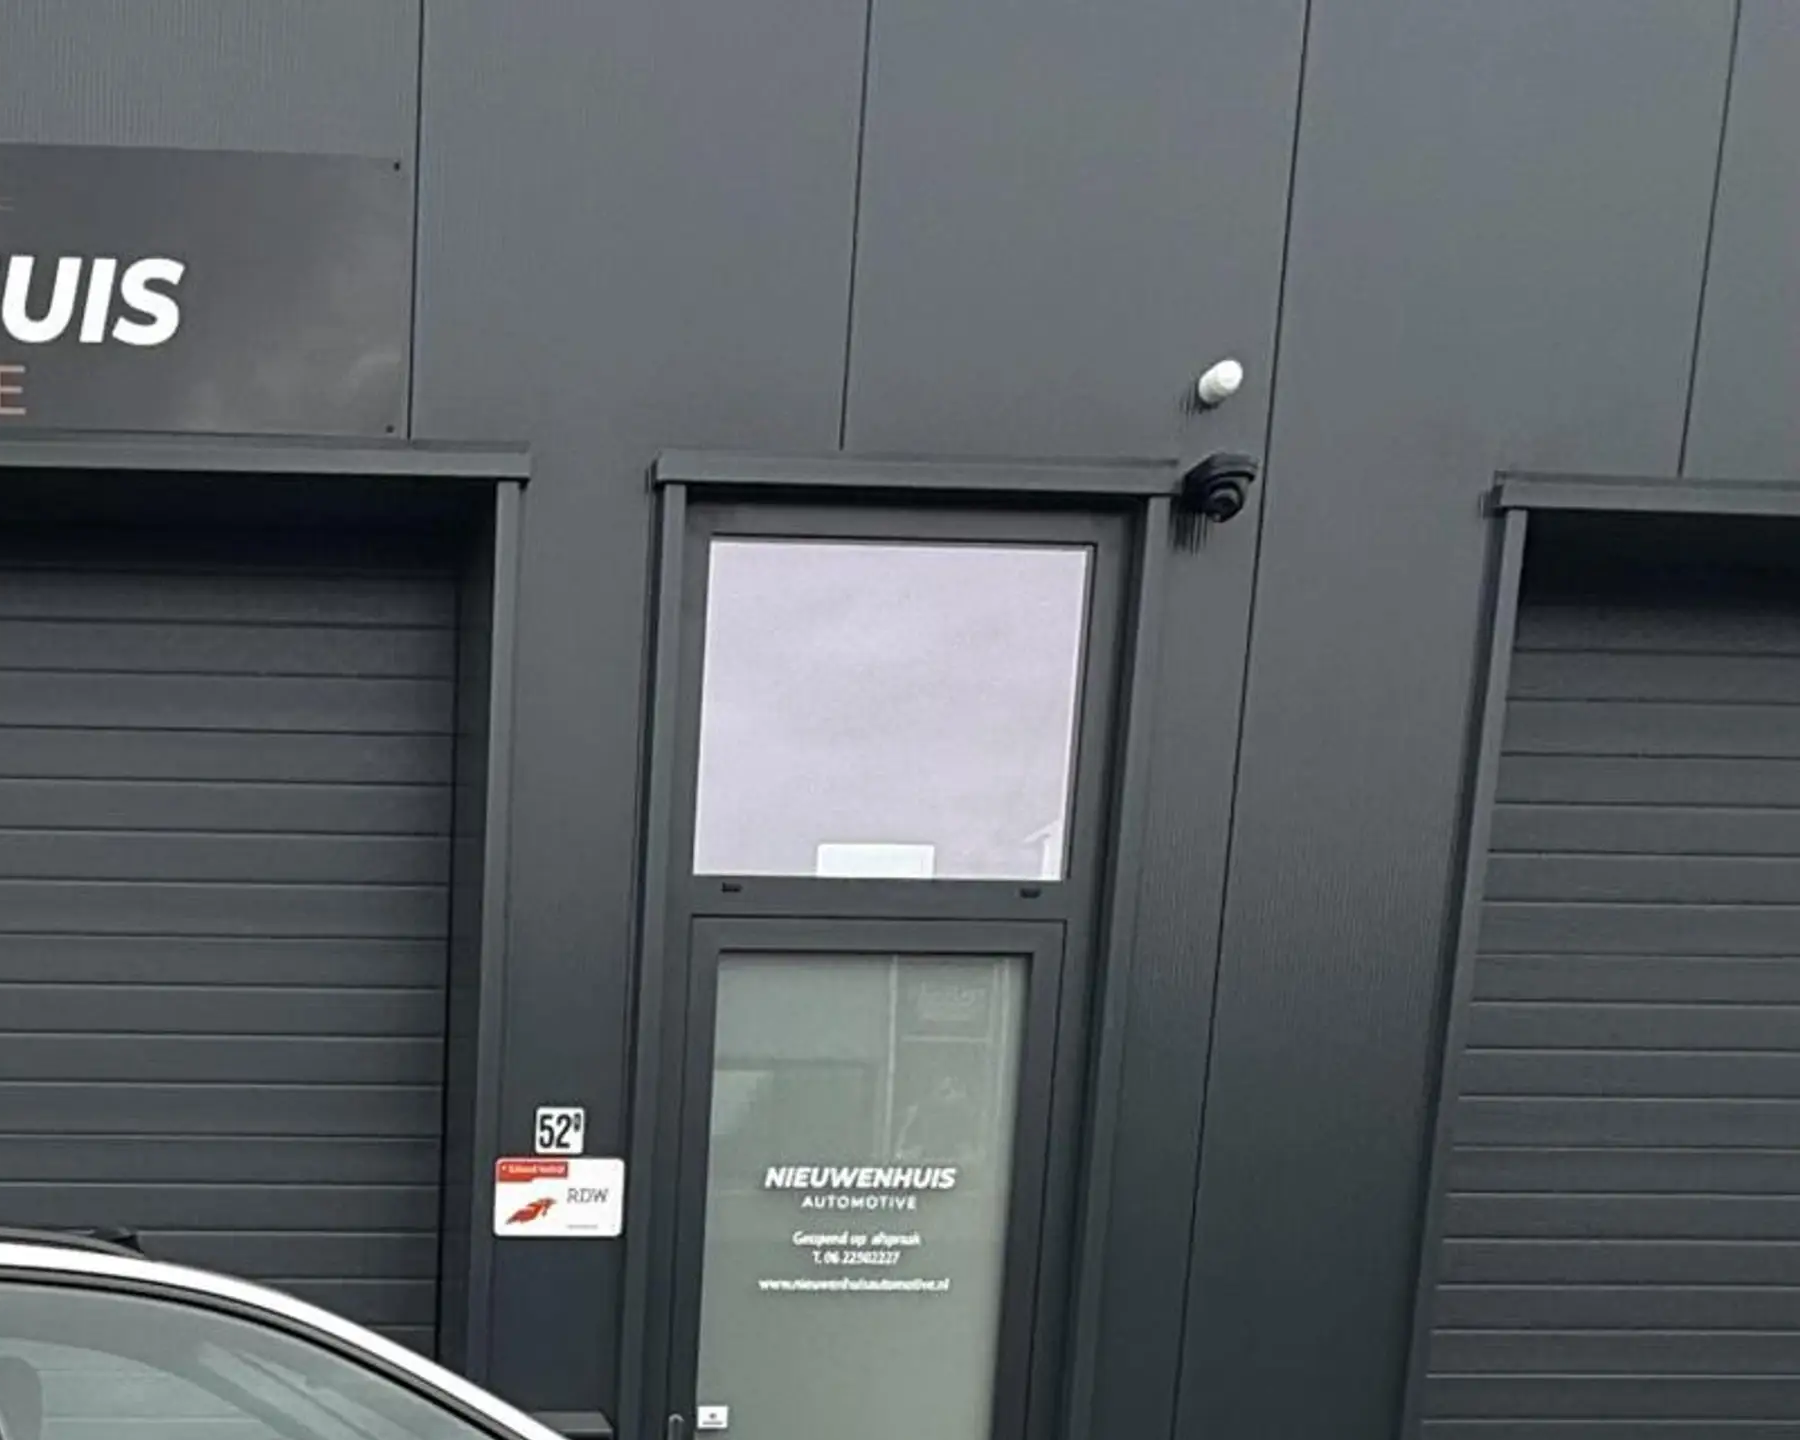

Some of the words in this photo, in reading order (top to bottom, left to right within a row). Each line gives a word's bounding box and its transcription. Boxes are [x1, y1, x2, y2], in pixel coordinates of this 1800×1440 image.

[764, 1166, 957, 1189] NIEUWENHUIS
[566, 1187, 609, 1203] RDW
[801, 1194, 917, 1210] AUTOMOTIVE
